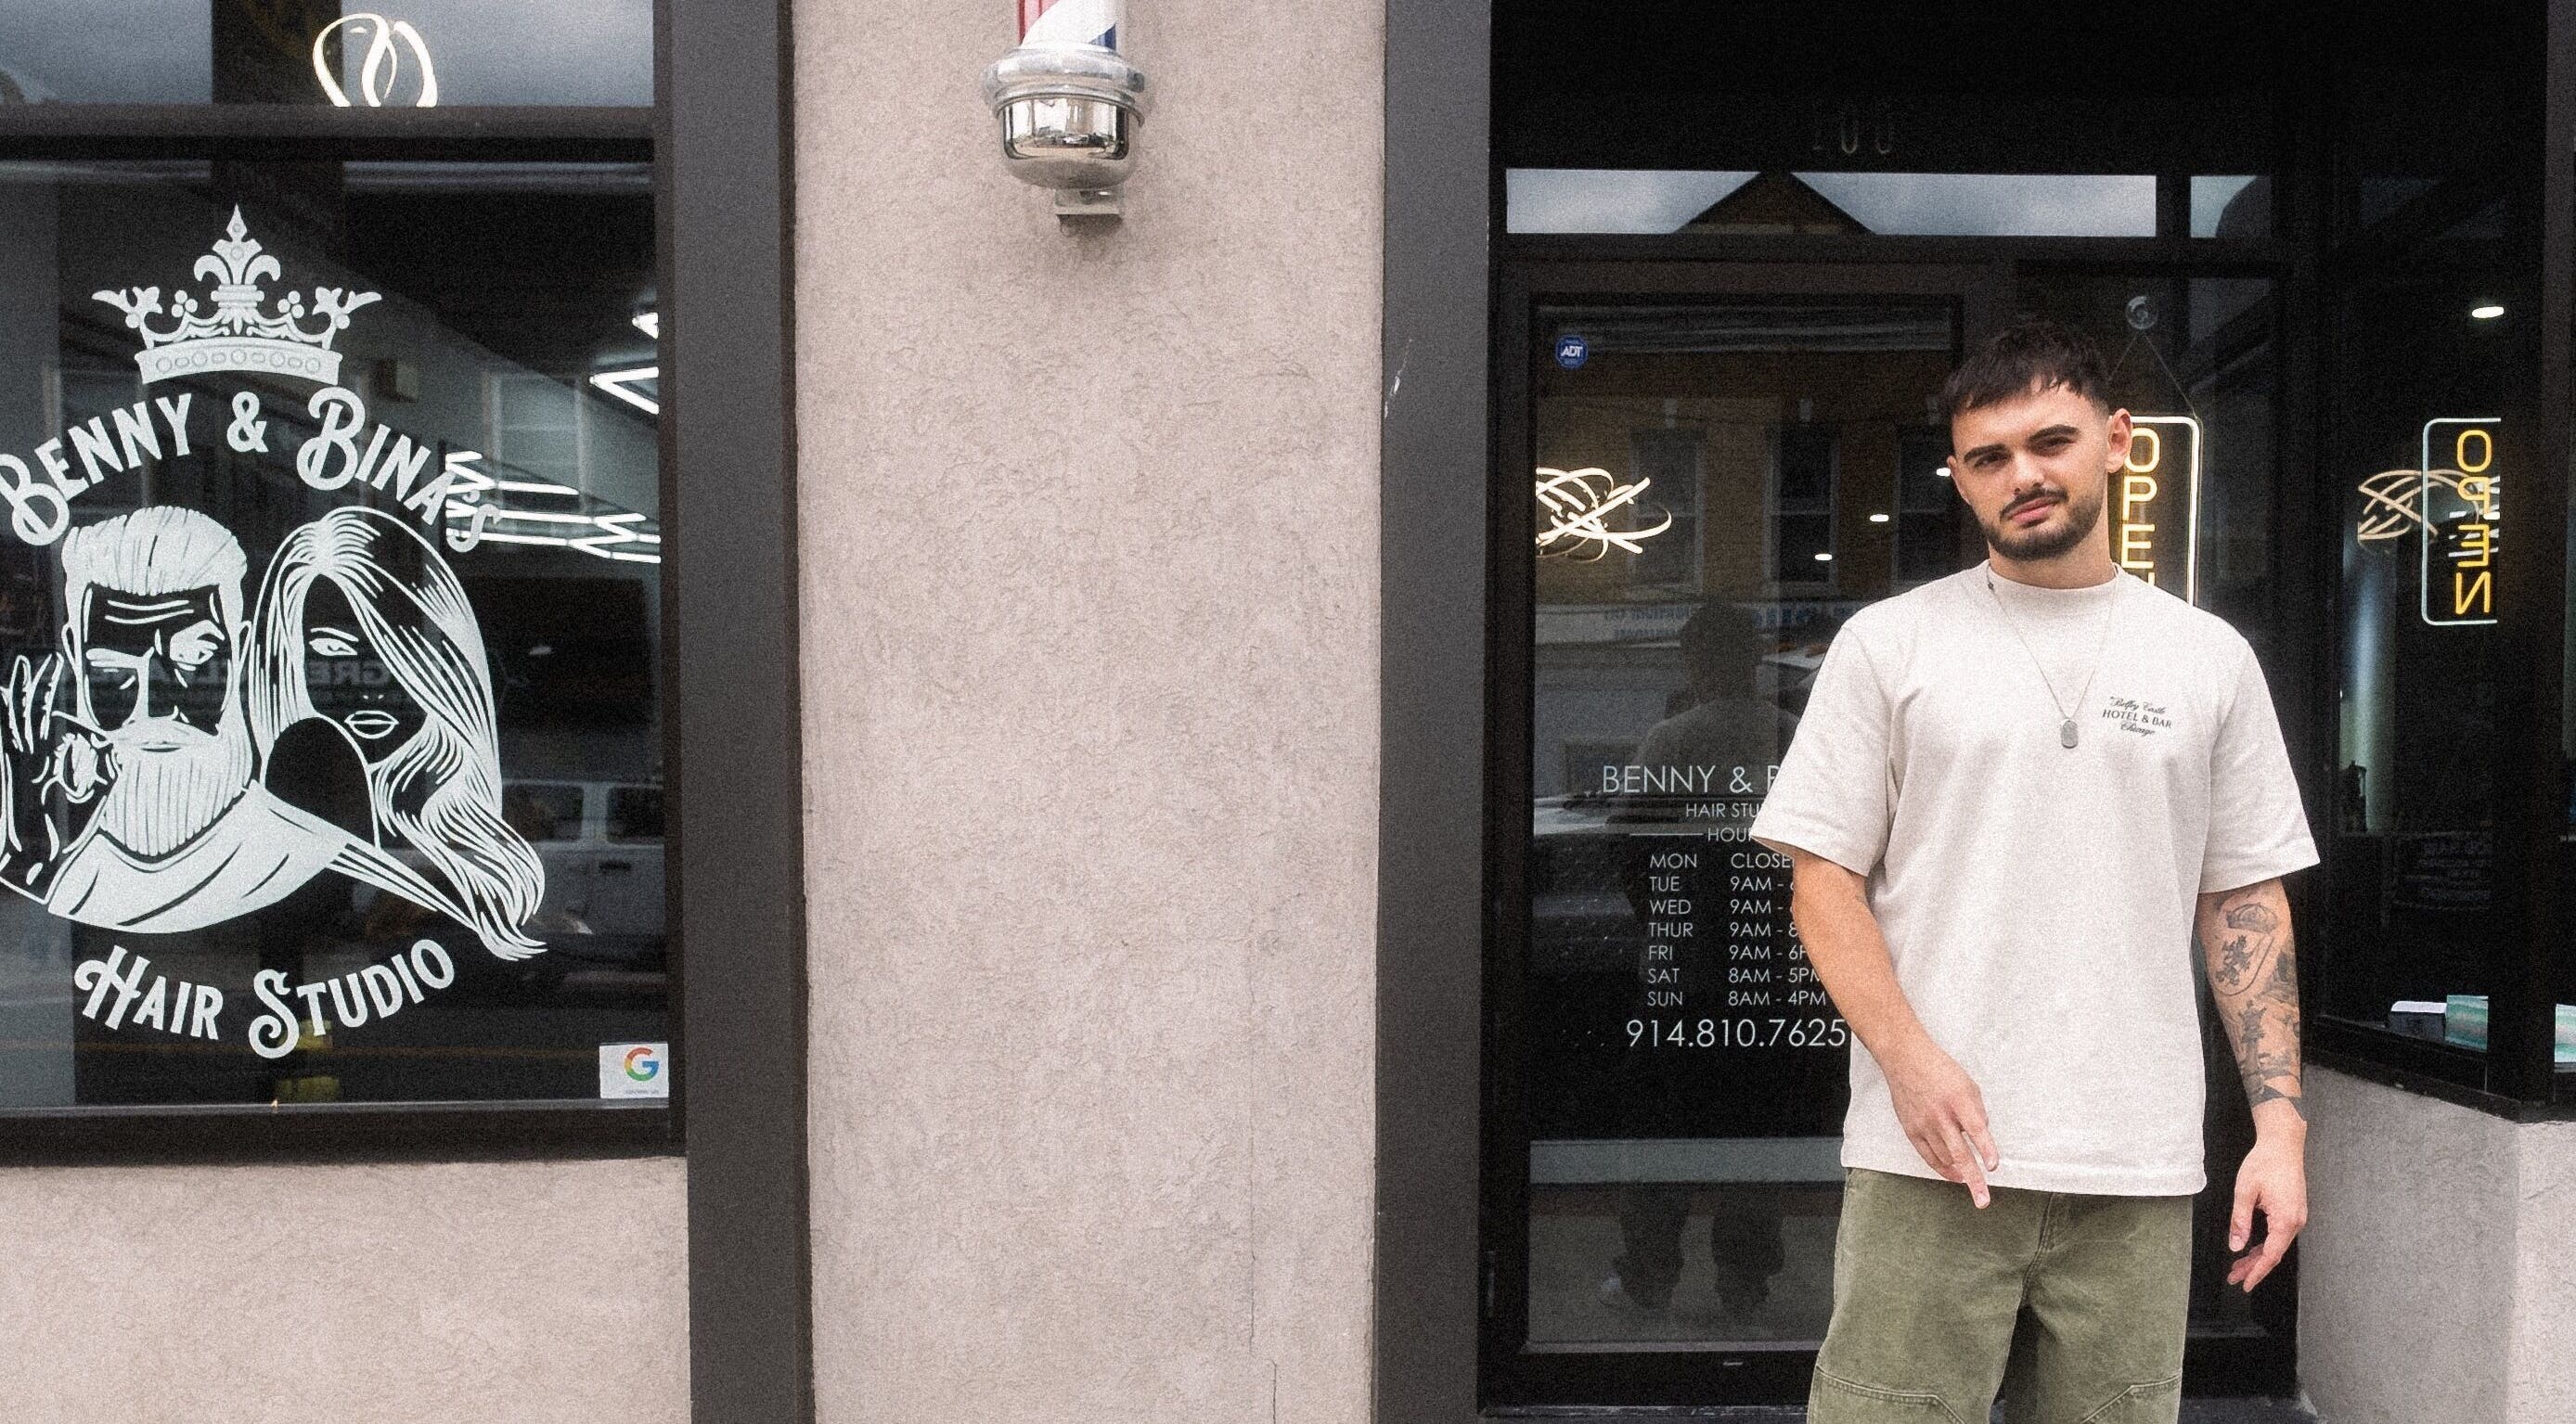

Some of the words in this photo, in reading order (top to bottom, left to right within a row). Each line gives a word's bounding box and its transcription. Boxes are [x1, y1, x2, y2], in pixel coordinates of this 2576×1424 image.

[1561, 345, 1583, 357] ADT
[0, 393, 193, 545] BENNY
[226, 391, 269, 453] &
[2121, 427, 2160, 586] OPE
[2102, 709, 2138, 722] HOTEL
[2142, 714, 2149, 724] &
[2152, 716, 2172, 729] BAR
[1603, 765, 1716, 793] BENNY
[1729, 766, 1753, 793] &
[1686, 803, 1726, 817] HAIR
[1732, 802, 1759, 817] STU
[1707, 827, 1751, 841] HOU
[1650, 853, 1697, 868] MON
[1731, 853, 1795, 868] CLOSE
[1650, 877, 1680, 892] TUE
[1730, 876, 1771, 892] 9AM
[1650, 899, 1692, 914] WED
[1730, 898, 1771, 914] 9AM
[1649, 922, 1694, 937] THUR
[1729, 921, 1771, 937] 9AM
[1648, 945, 1673, 960] FRI
[1729, 944, 1771, 960] 9AM
[1647, 968, 1680, 983] SAT
[1728, 968, 1771, 983] 8AM
[74, 944, 224, 1041] HAIR
[249, 939, 455, 1059] STUDIO
[1647, 991, 1682, 1007] SUN
[1728, 990, 1770, 1006] 8AM
[1787, 991, 1826, 1006] 4PM
[1627, 1019, 1846, 1047] 914.810.7625
[624, 1047, 660, 1082] G
